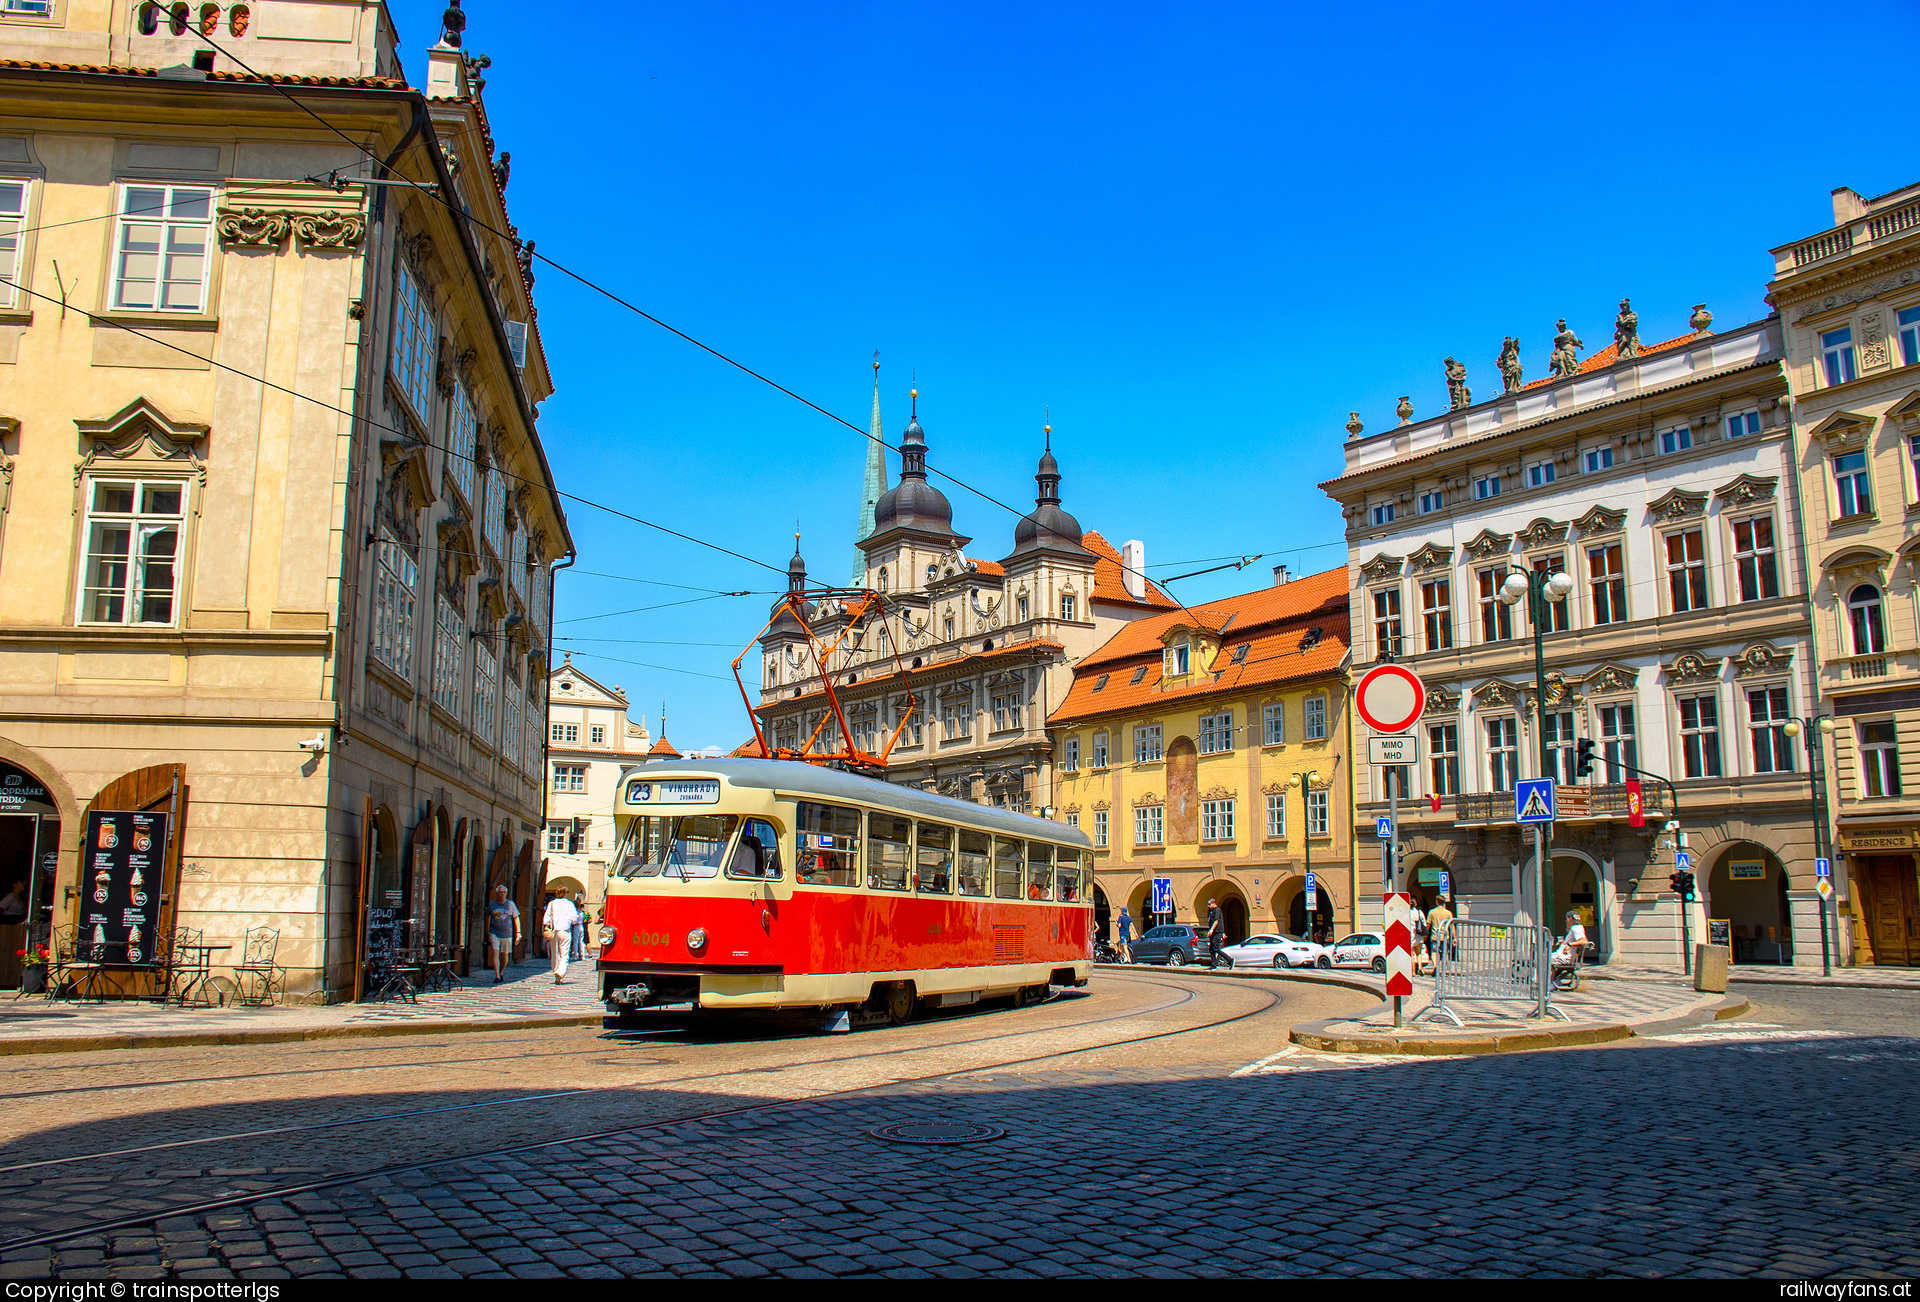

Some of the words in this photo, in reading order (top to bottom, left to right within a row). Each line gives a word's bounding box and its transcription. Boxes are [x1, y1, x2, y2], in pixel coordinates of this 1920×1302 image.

[1381, 740, 1403, 749] MIMO
[1383, 751, 1402, 760] MHD
[632, 783, 651, 801] 23
[668, 783, 717, 793] VINOHRADY
[1851, 837, 1907, 848] RESIDENCE
[631, 932, 669, 947] 6004
